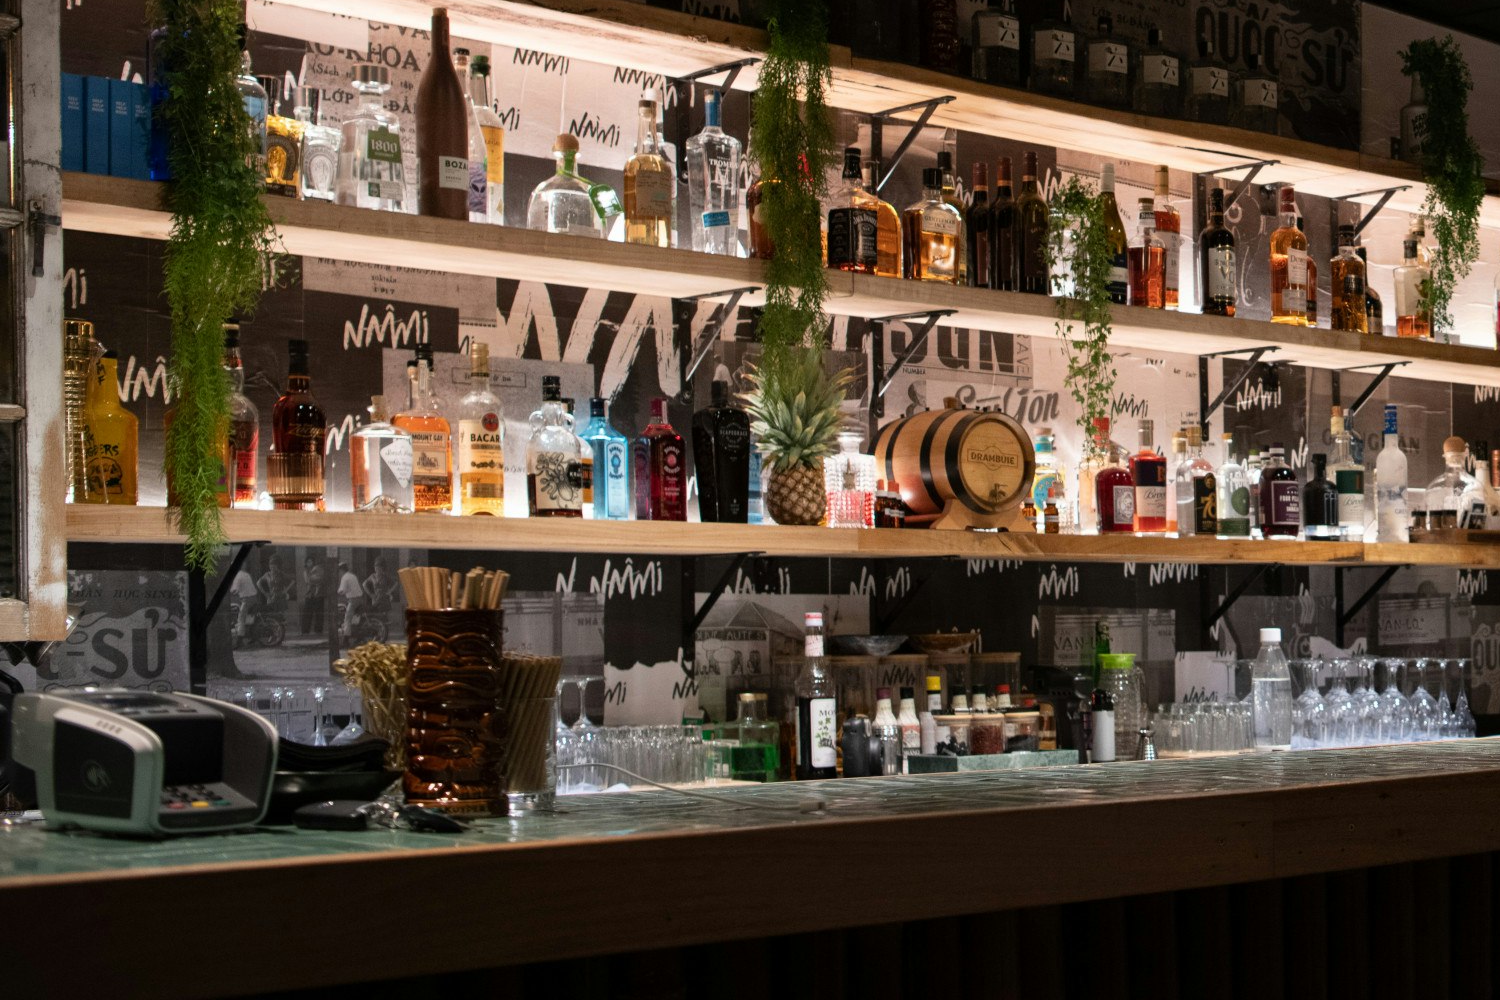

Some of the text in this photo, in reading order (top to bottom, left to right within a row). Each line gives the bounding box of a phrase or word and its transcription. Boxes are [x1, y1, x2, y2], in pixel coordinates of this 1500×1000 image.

[370, 140, 398, 153] 1800
[412, 433, 432, 441] MOUNT
[470, 433, 501, 443] BACAR
[970, 450, 1015, 466] DRAMBUIE
